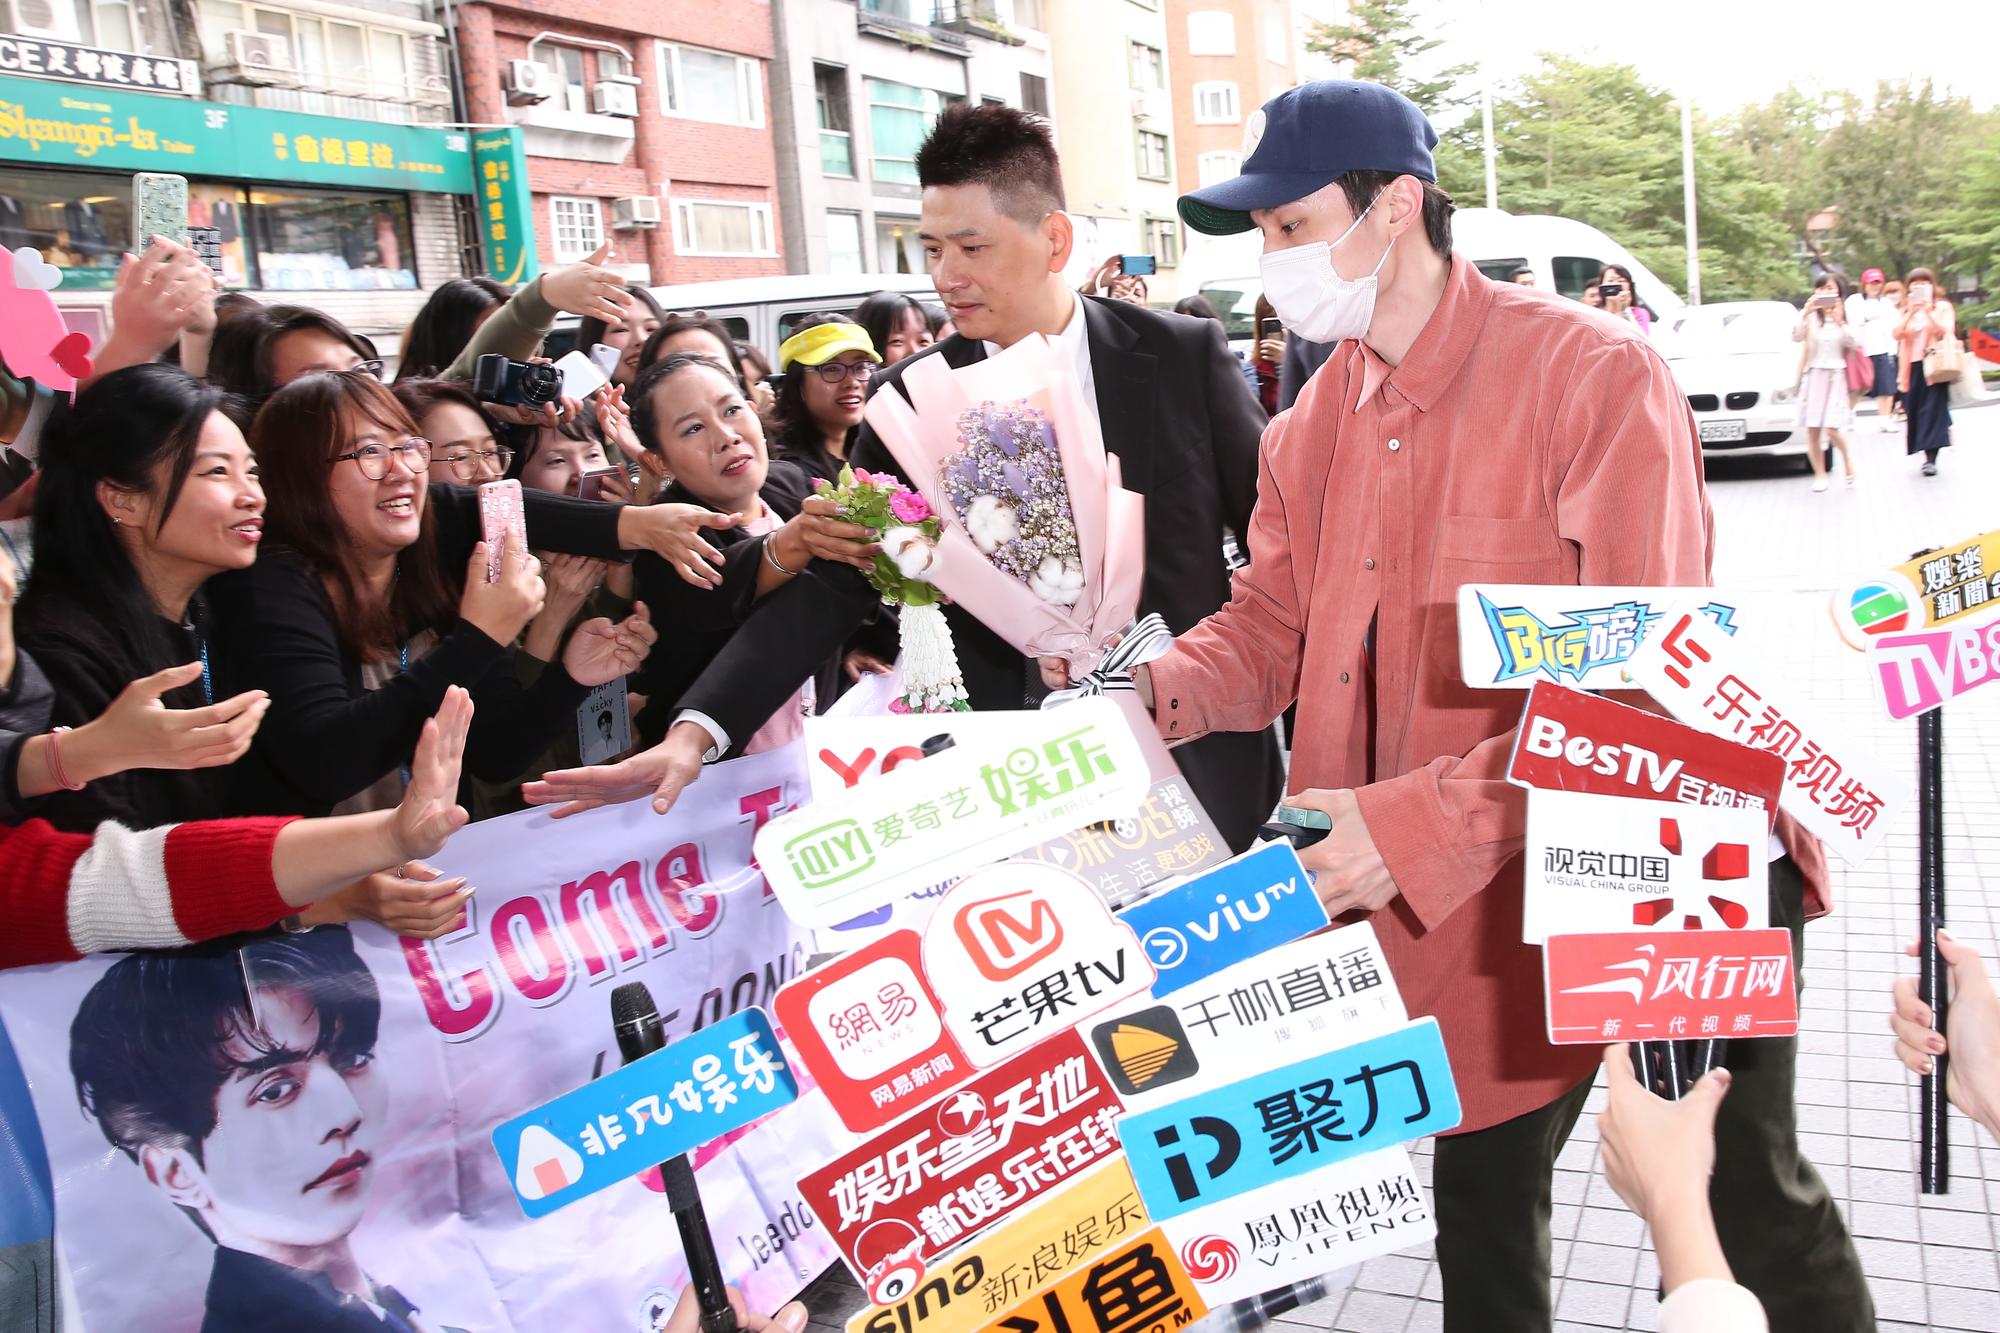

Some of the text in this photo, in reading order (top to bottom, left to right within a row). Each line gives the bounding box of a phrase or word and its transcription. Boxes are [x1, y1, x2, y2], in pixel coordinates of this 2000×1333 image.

[203, 109, 228, 129] 3F
[979, 725, 1118, 818] 娱乐
[1526, 715, 1684, 793] BesTV
[1703, 675, 1885, 839] 乐视视频
[871, 786, 979, 848] 爱奇艺
[1158, 783, 1199, 830] 视频
[1544, 875, 1670, 895] VISUAL CHINA GROUP
[1545, 847, 1669, 882] 视觉中国
[403, 842, 718, 1034] Come
[1182, 946, 1383, 1037] 千帆直播
[1650, 955, 1787, 1000] 风行网
[862, 1025, 915, 1056] NEWS
[1602, 1014, 1752, 1037] 新一代视频
[579, 1031, 785, 1156] 非凡娱乐
[869, 1052, 955, 1109] 网易新闻
[1254, 1060, 1431, 1166] 聚力
[917, 1105, 1121, 1248] 新娱乐在线
[1244, 1174, 1420, 1255] 鳳凰視頻
[981, 1192, 1143, 1314] 新浪娱乐
